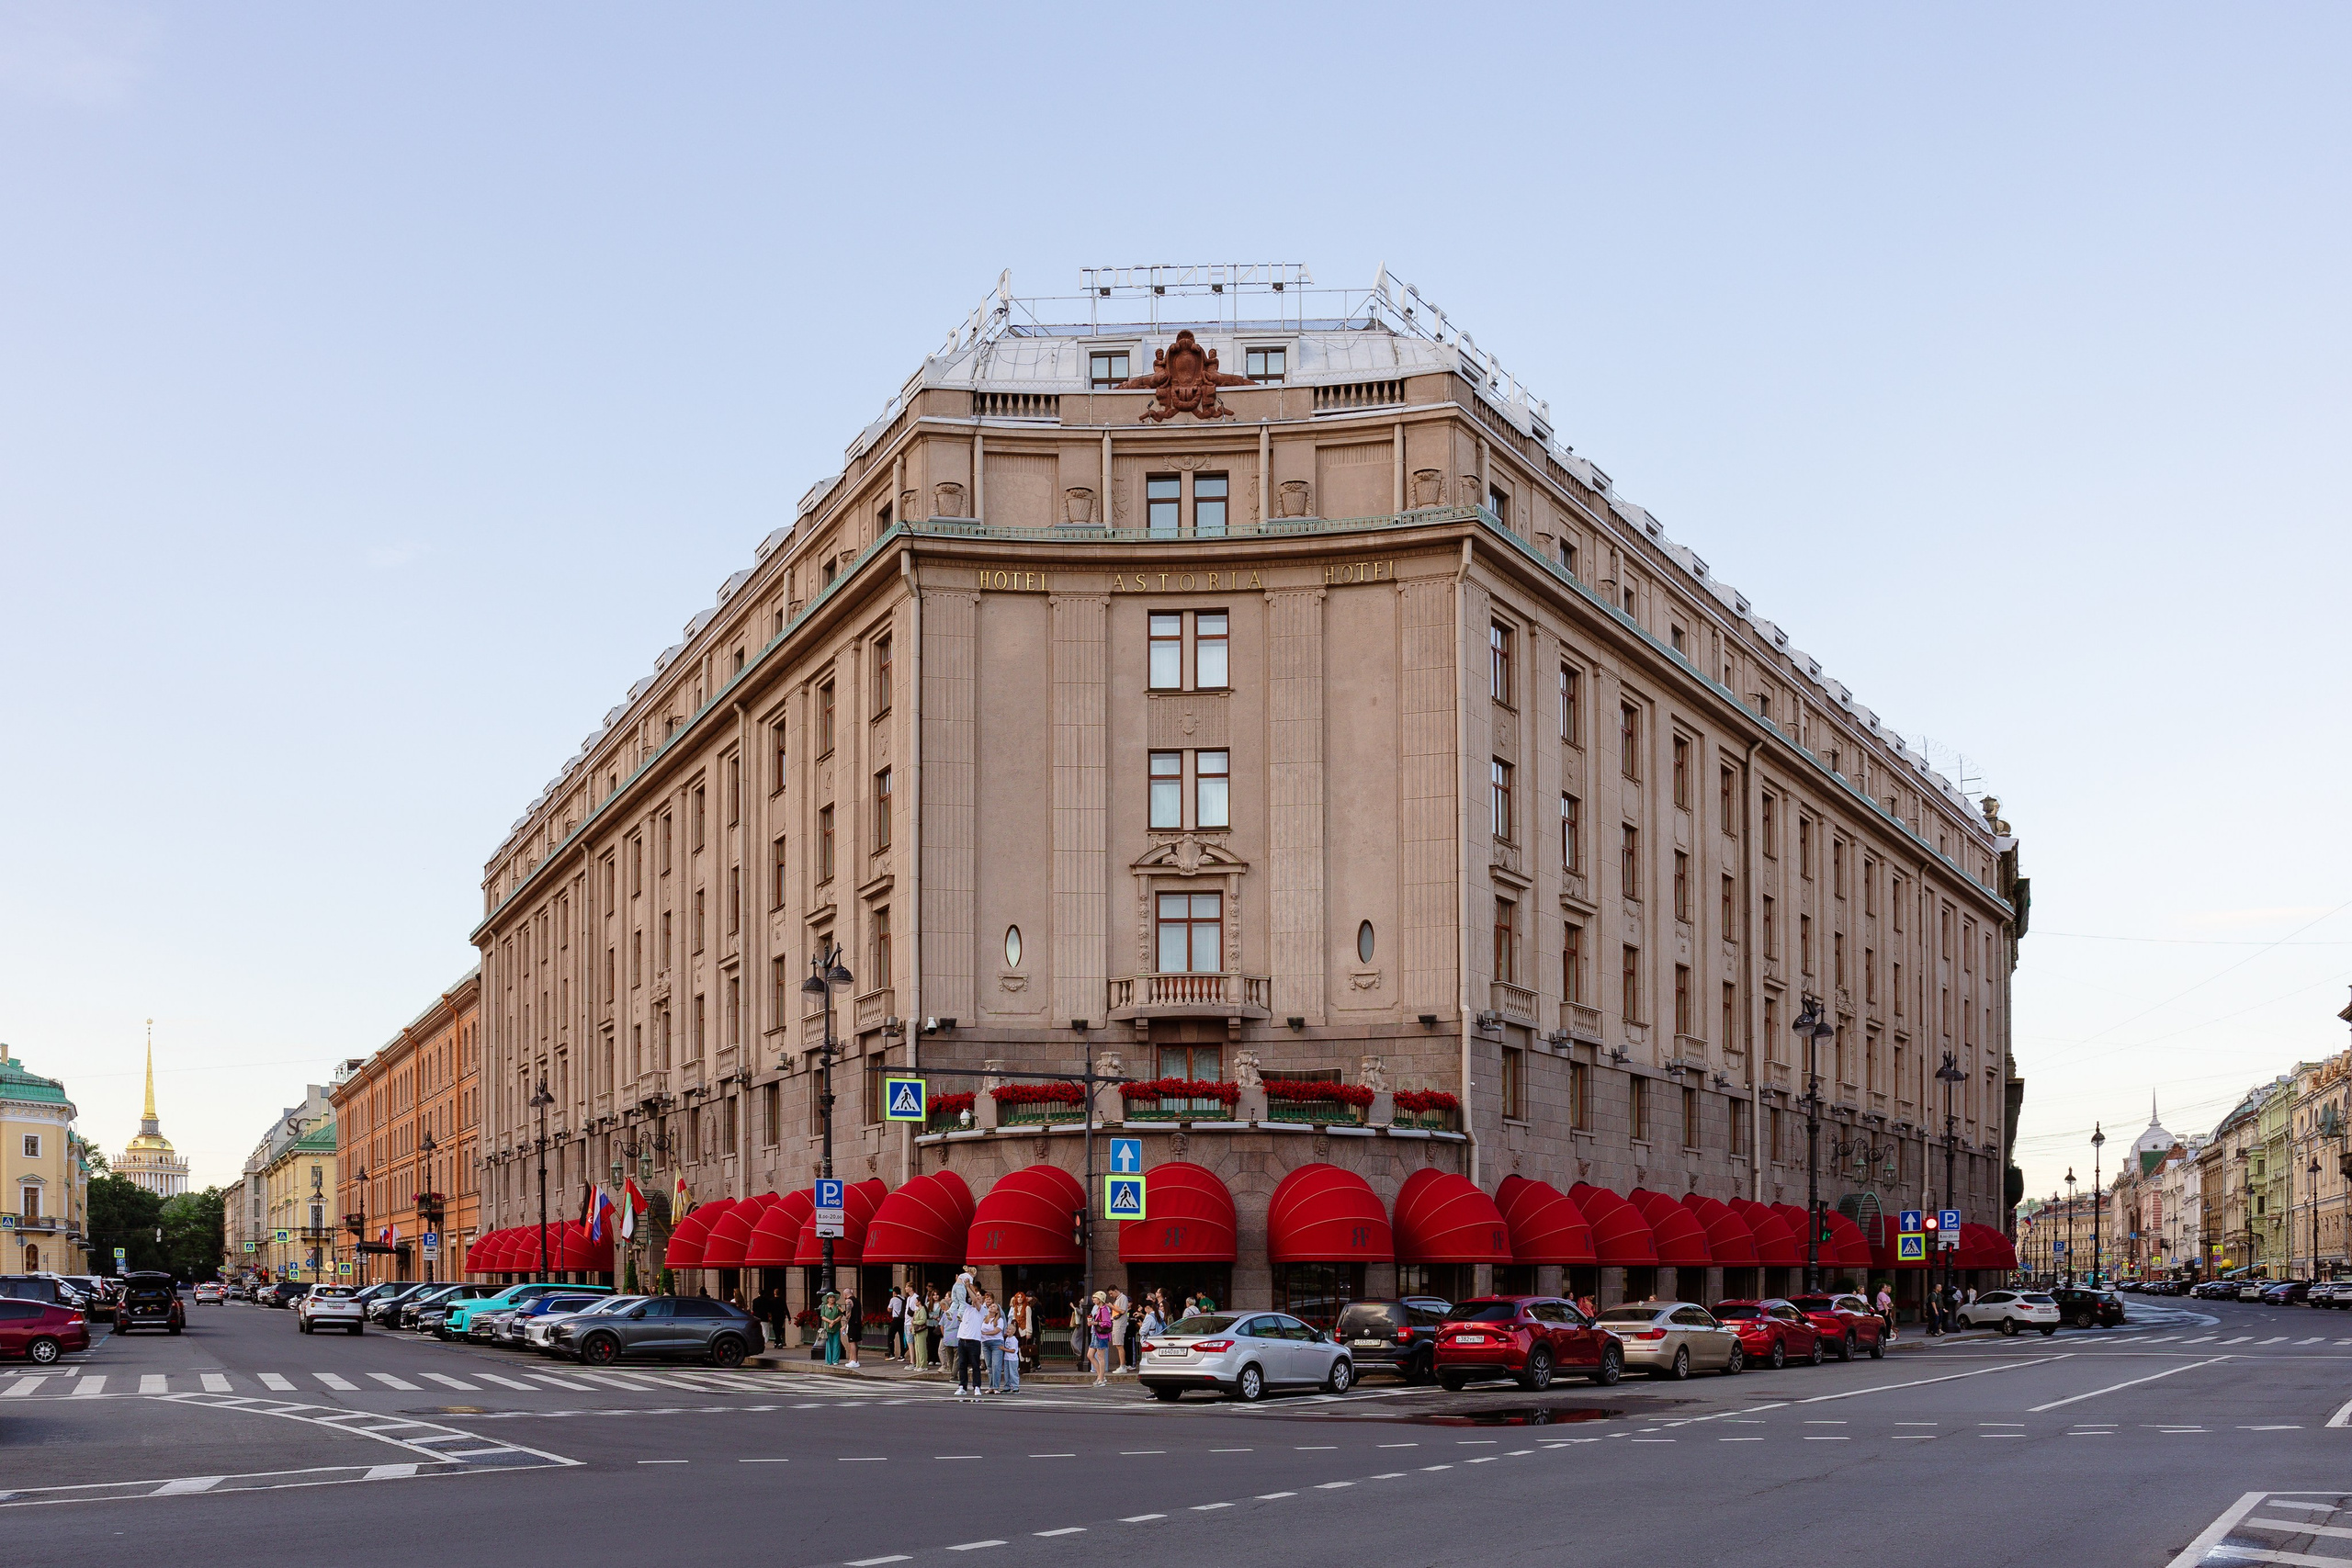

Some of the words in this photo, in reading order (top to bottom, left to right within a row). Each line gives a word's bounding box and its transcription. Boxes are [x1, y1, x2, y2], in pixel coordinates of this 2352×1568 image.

[980, 571, 1049, 591] HOTEL
[1114, 570, 1262, 592] ASTORIA
[1325, 561, 1396, 584] HOTEL
[823, 1182, 838, 1204] P
[1945, 1213, 1956, 1228] P
